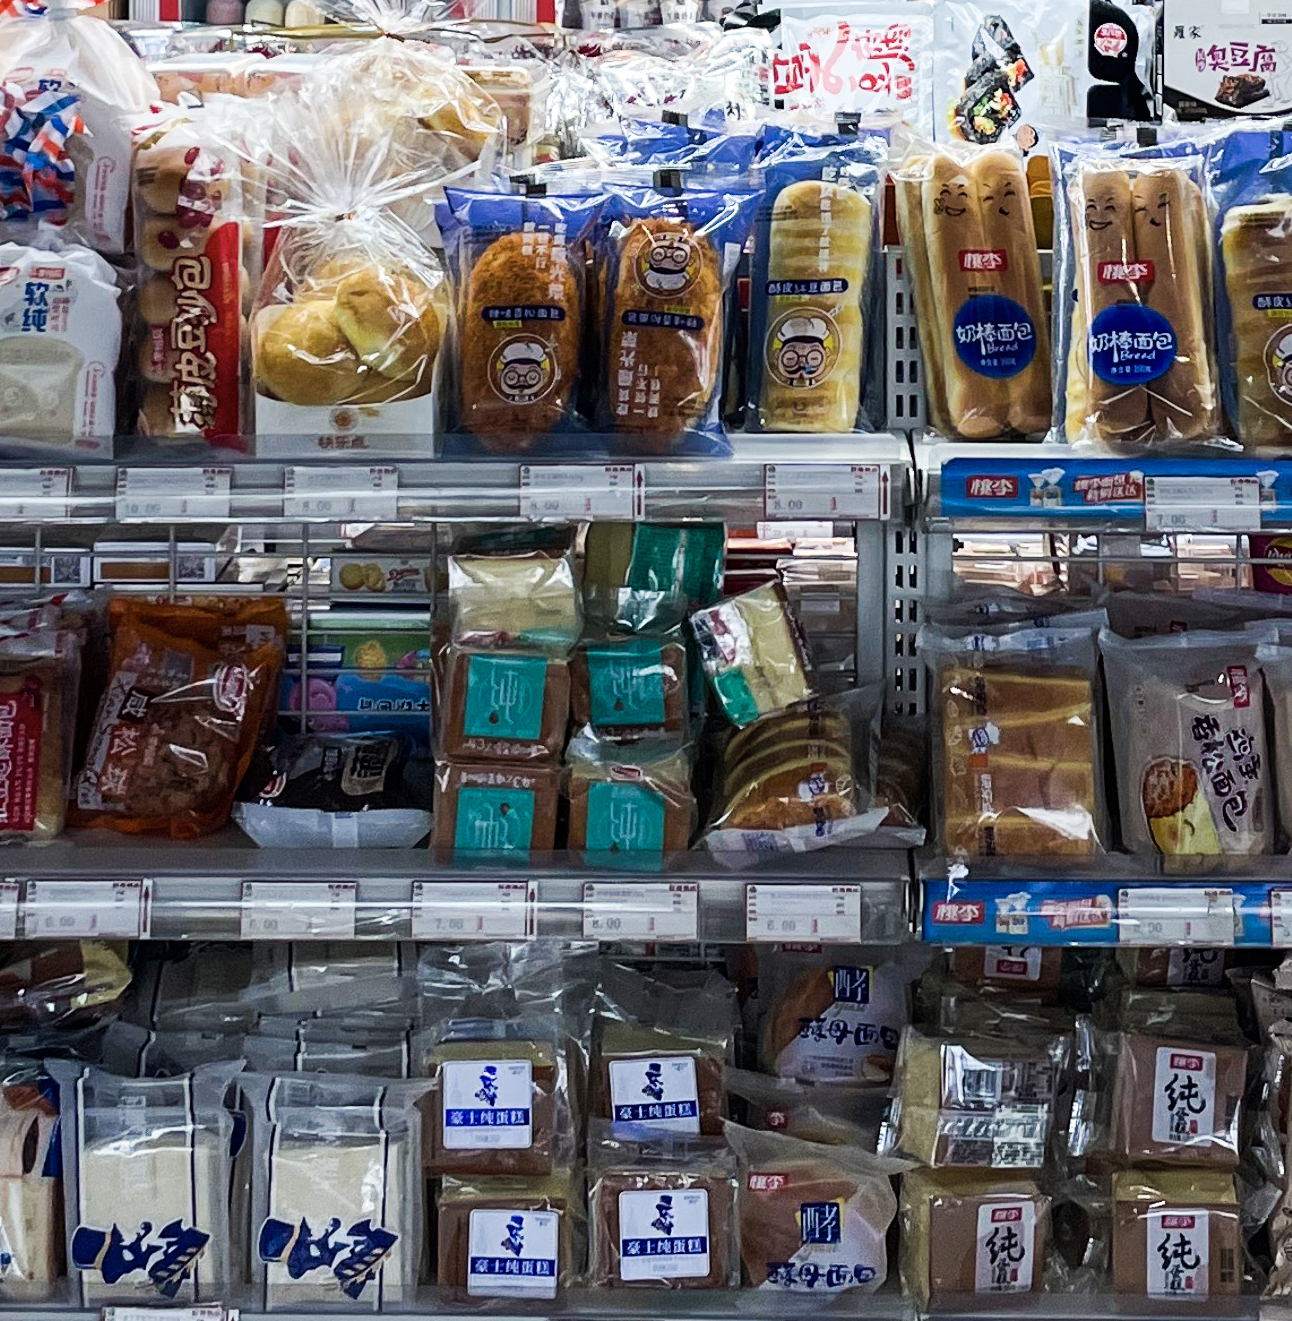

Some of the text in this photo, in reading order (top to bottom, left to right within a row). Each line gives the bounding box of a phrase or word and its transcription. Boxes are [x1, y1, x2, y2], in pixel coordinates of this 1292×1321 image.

[1208, 41, 1276, 72] 臭豆腐
[965, 252, 1002, 270] 桃李
[1102, 263, 1148, 281] 桃李
[21, 282, 50, 332] 软纯
[956, 322, 1033, 354] 奶棒面包
[1090, 329, 1173, 363] 奶棒面包
[1120, 347, 1157, 361] Bread
[970, 480, 1014, 496] 桃李
[834, 967, 869, 1002] 酵
[1164, 1073, 1207, 1114] 纯
[801, 1203, 841, 1242] 酵
[986, 1226, 1026, 1264] 纯
[1157, 1232, 1201, 1270] 纯
